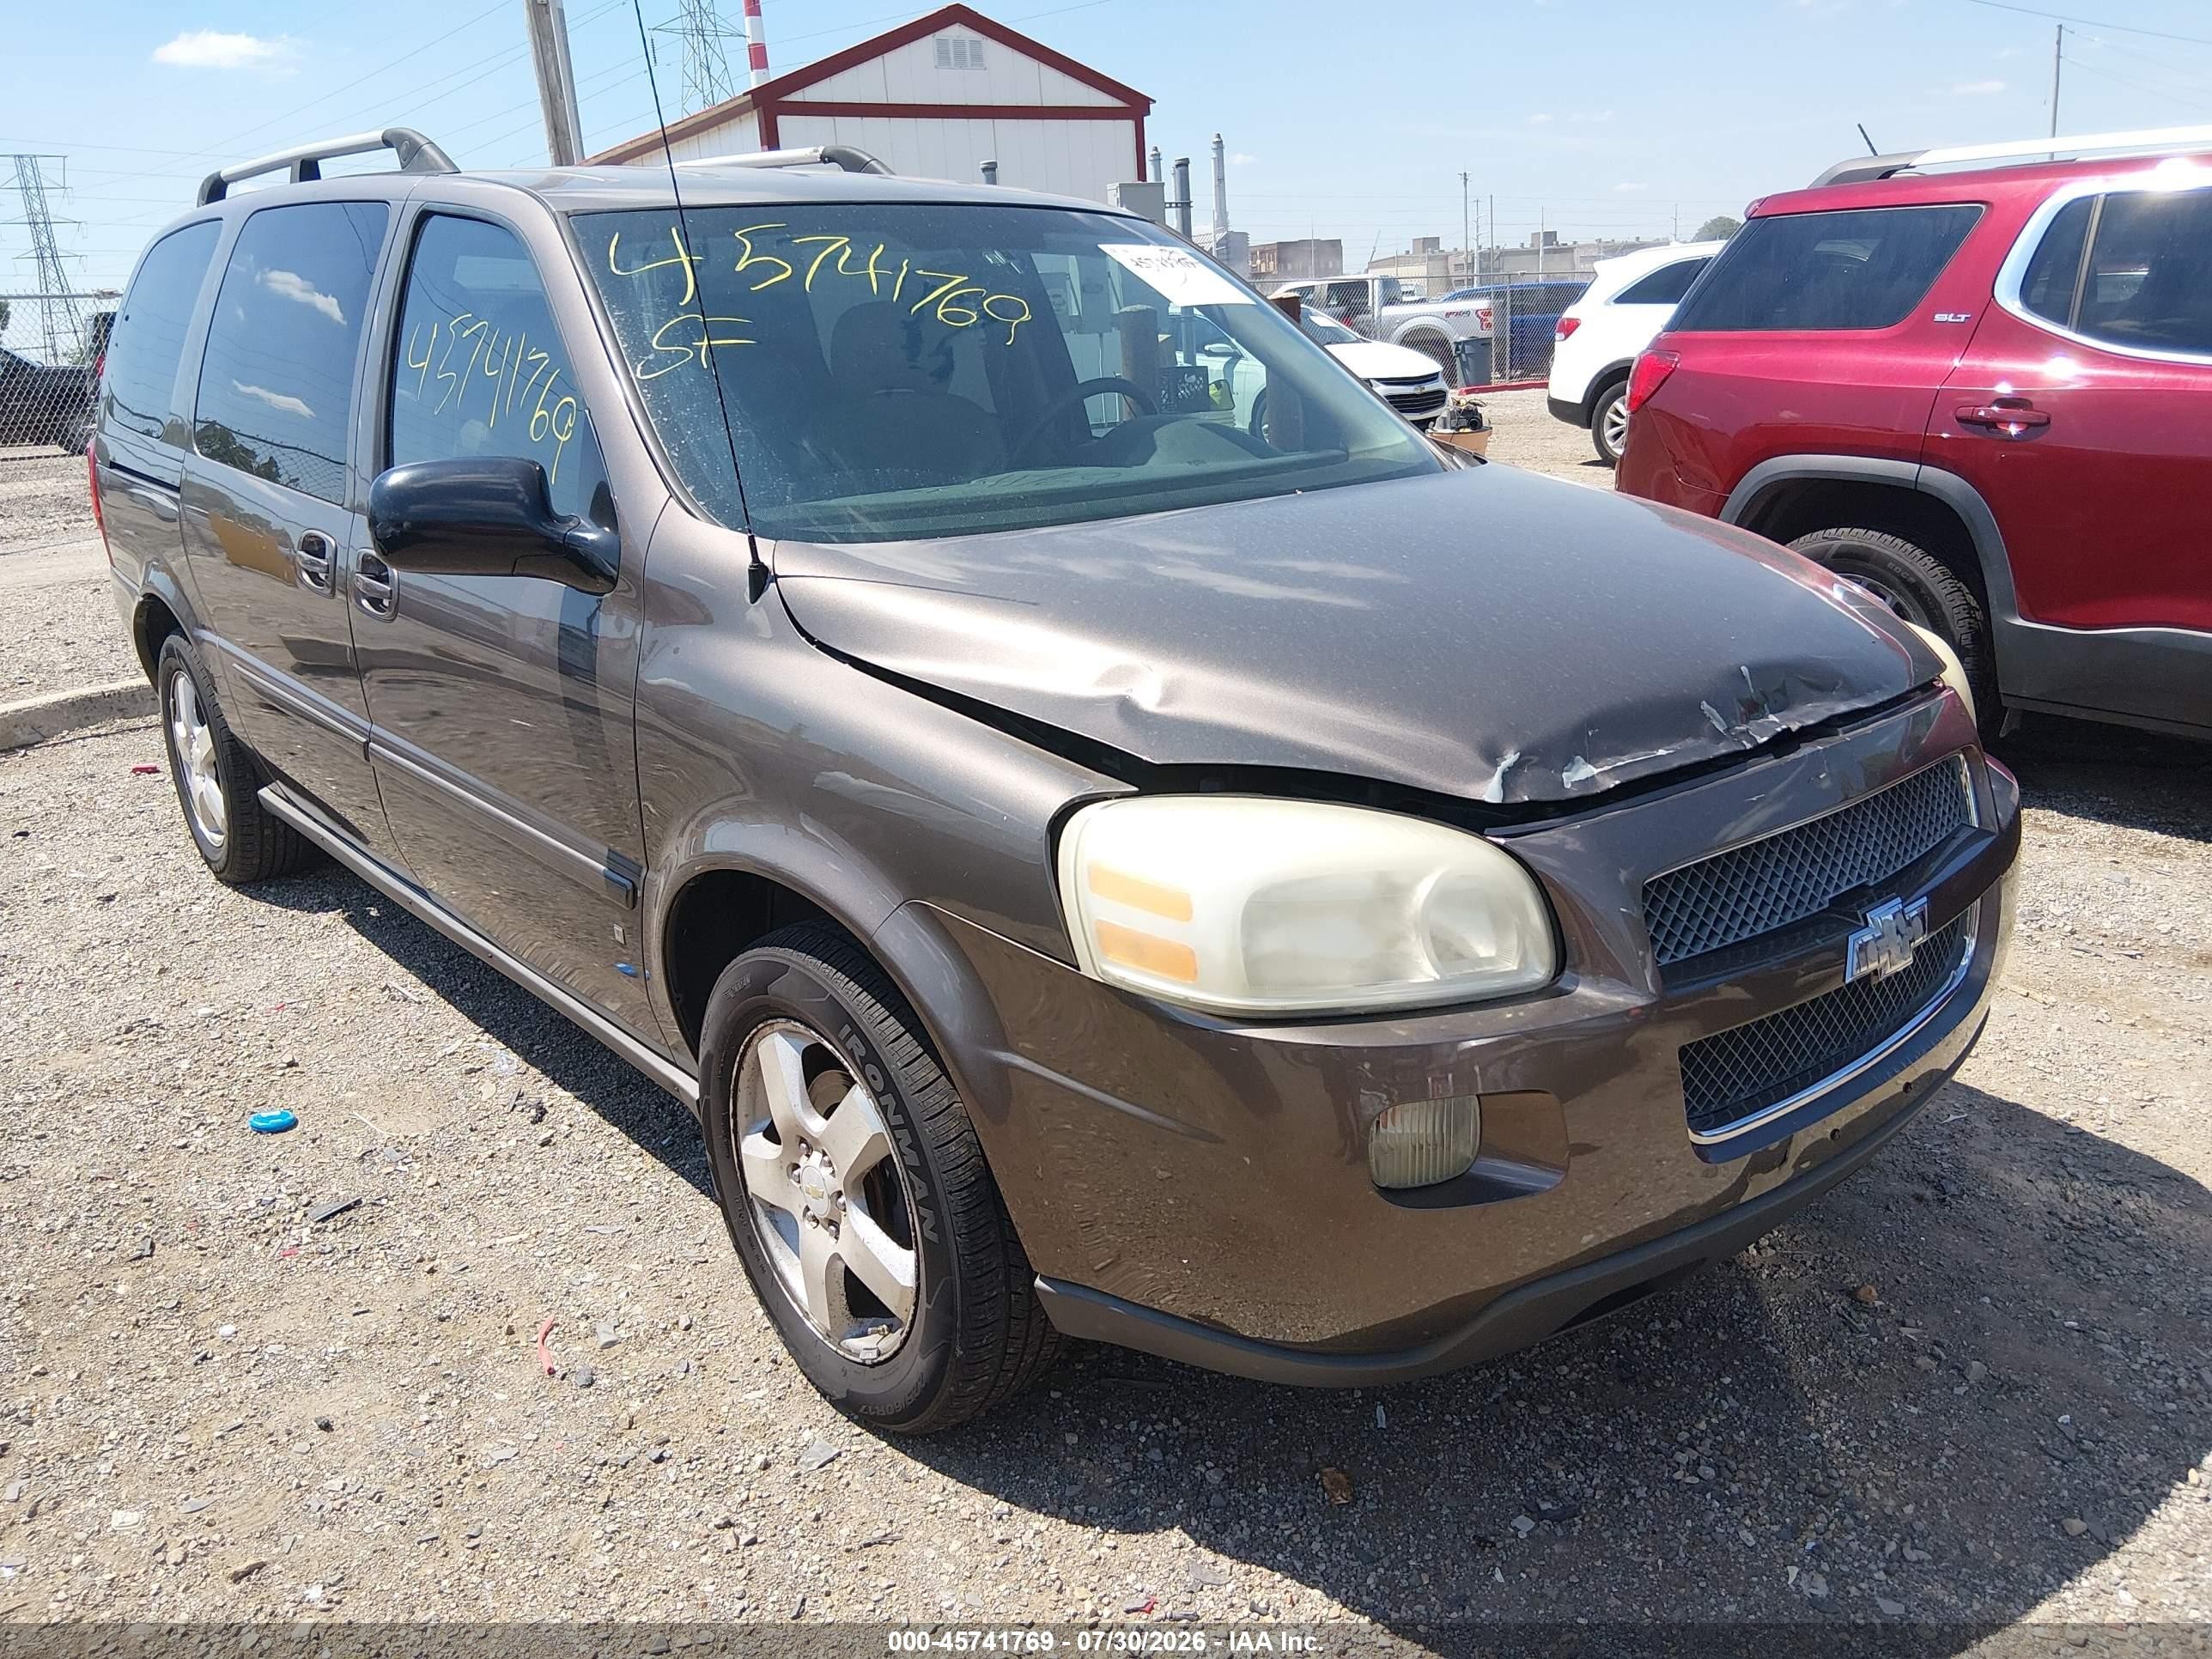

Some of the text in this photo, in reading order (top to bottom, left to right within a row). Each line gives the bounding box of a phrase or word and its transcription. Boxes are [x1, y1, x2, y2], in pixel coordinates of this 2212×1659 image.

[636, 313, 757, 380] SF
[1933, 313, 1971, 323] SLT
[408, 313, 577, 485] 45741769
[838, 1024, 939, 1244] IRONMAN
